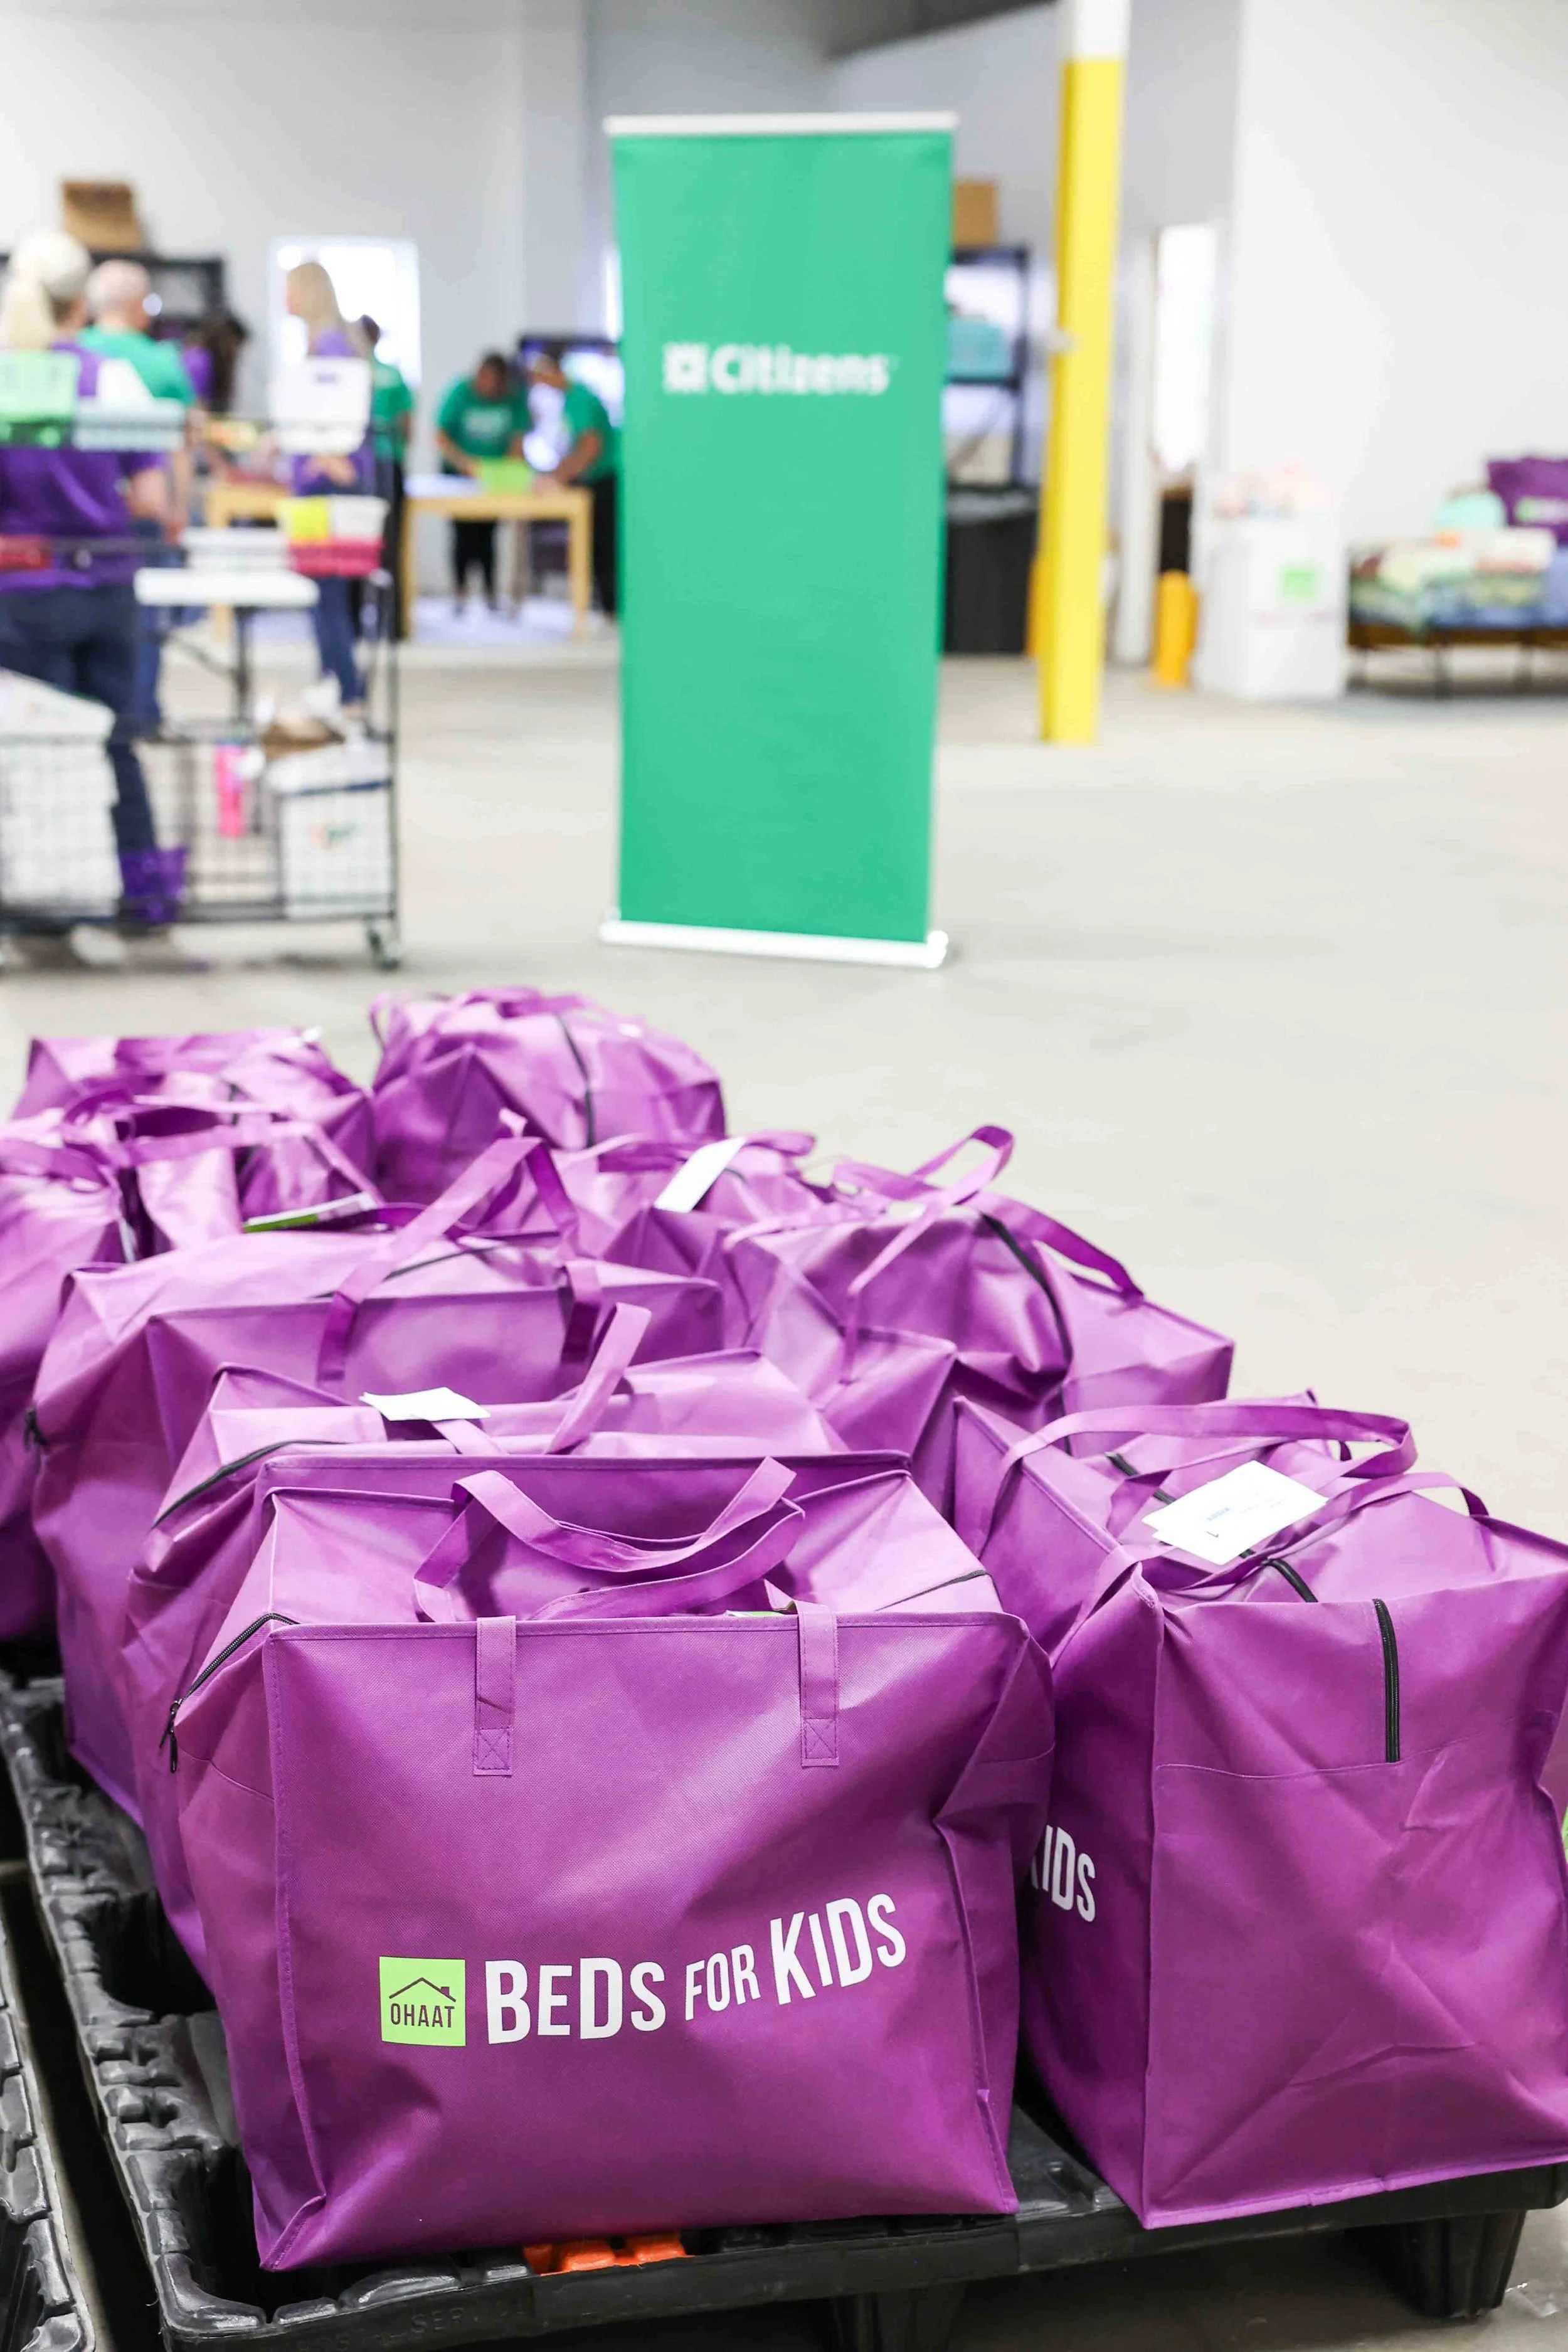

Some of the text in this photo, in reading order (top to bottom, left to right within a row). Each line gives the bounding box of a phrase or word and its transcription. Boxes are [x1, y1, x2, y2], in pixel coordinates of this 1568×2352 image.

[710, 342, 891, 395] Citizens
[1031, 1824, 1096, 1922] IDS
[484, 1893, 907, 2045] BEDS FOR KIDS
[390, 2002, 455, 2028] OHAAT
